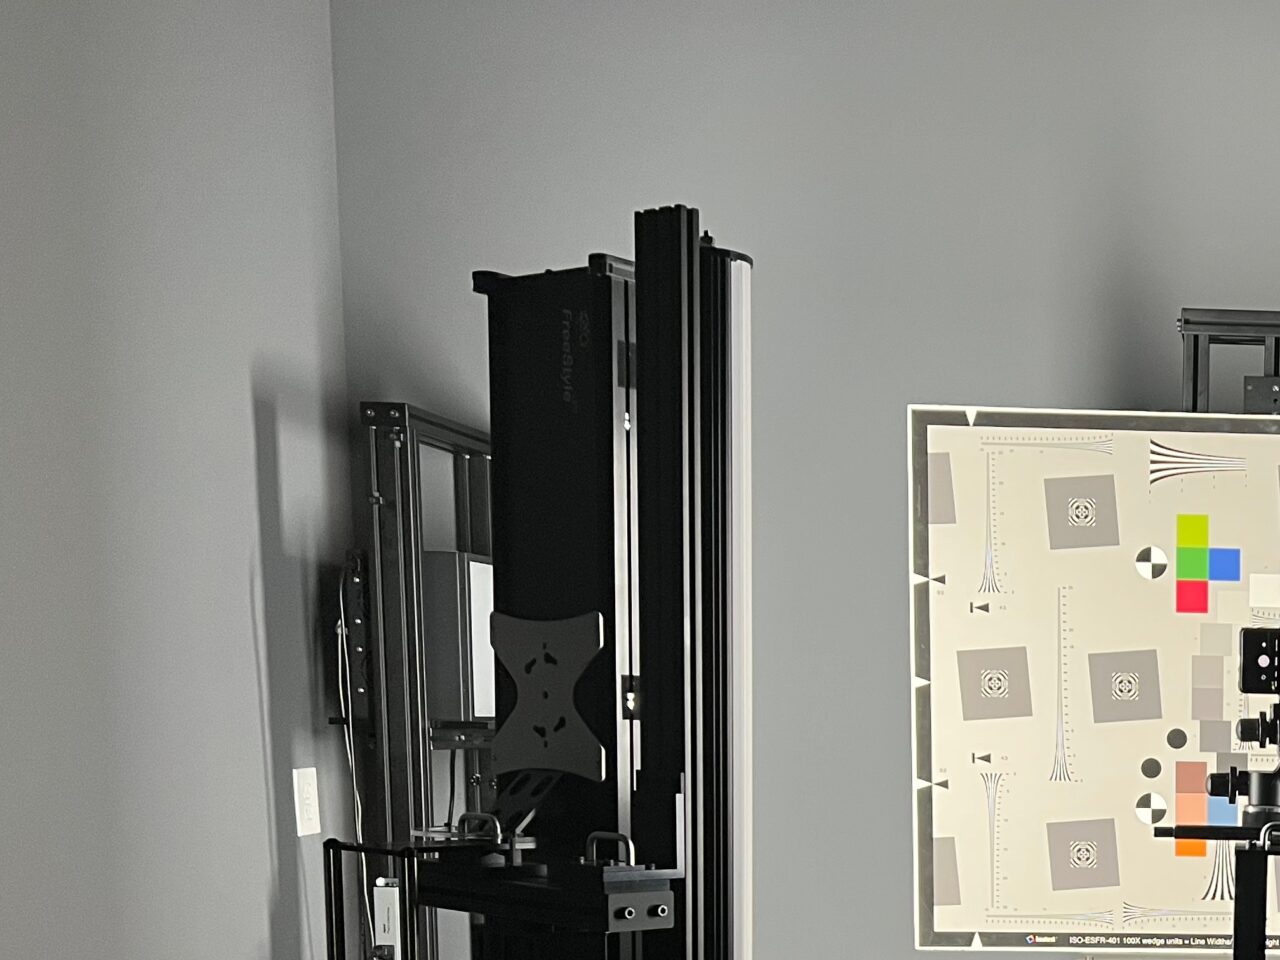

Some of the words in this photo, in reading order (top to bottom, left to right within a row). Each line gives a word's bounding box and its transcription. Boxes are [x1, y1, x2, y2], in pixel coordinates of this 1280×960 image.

[1069, 935, 1121, 945] ISO-ESFR-401
[1122, 936, 1141, 945] 100X
[1142, 937, 1165, 947] wedge
[1165, 937, 1183, 946] units
[1190, 937, 1207, 946] Line
[1206, 937, 1234, 946] Widths/
